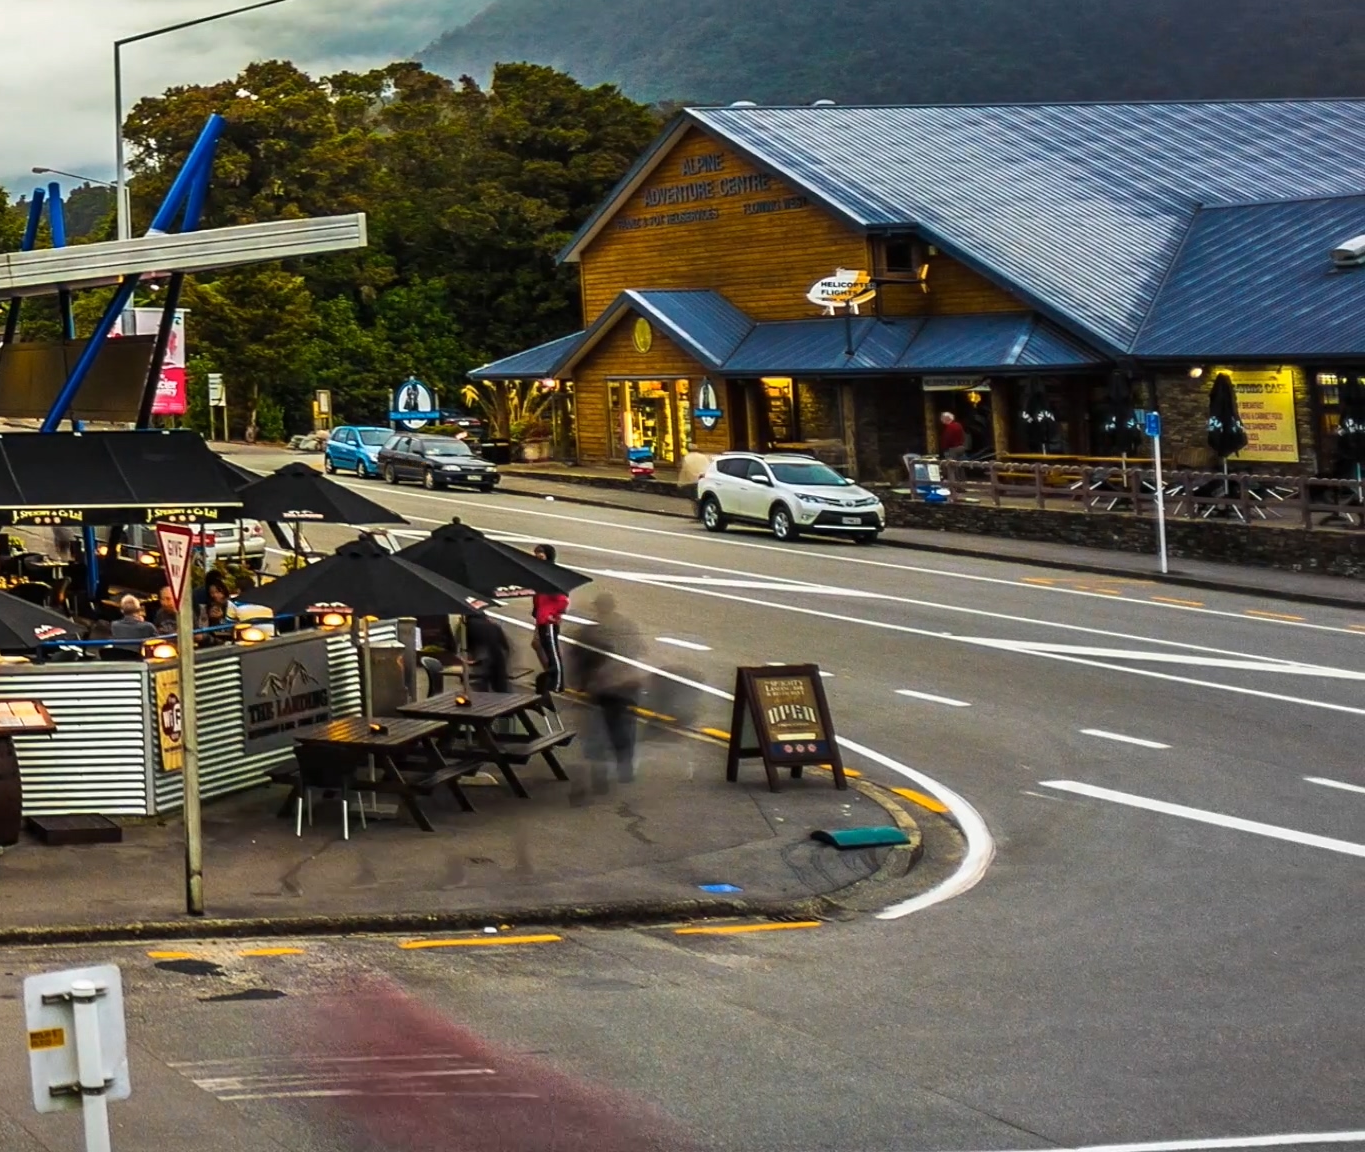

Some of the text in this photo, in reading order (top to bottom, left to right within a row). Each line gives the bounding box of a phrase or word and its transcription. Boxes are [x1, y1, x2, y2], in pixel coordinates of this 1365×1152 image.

[681, 153, 723, 176] ALPINE
[643, 173, 769, 207] ADVENTURE CENTRE
[168, 539, 183, 558] GIVE
[248, 701, 274, 724] THE
[768, 704, 817, 724] OPEN
